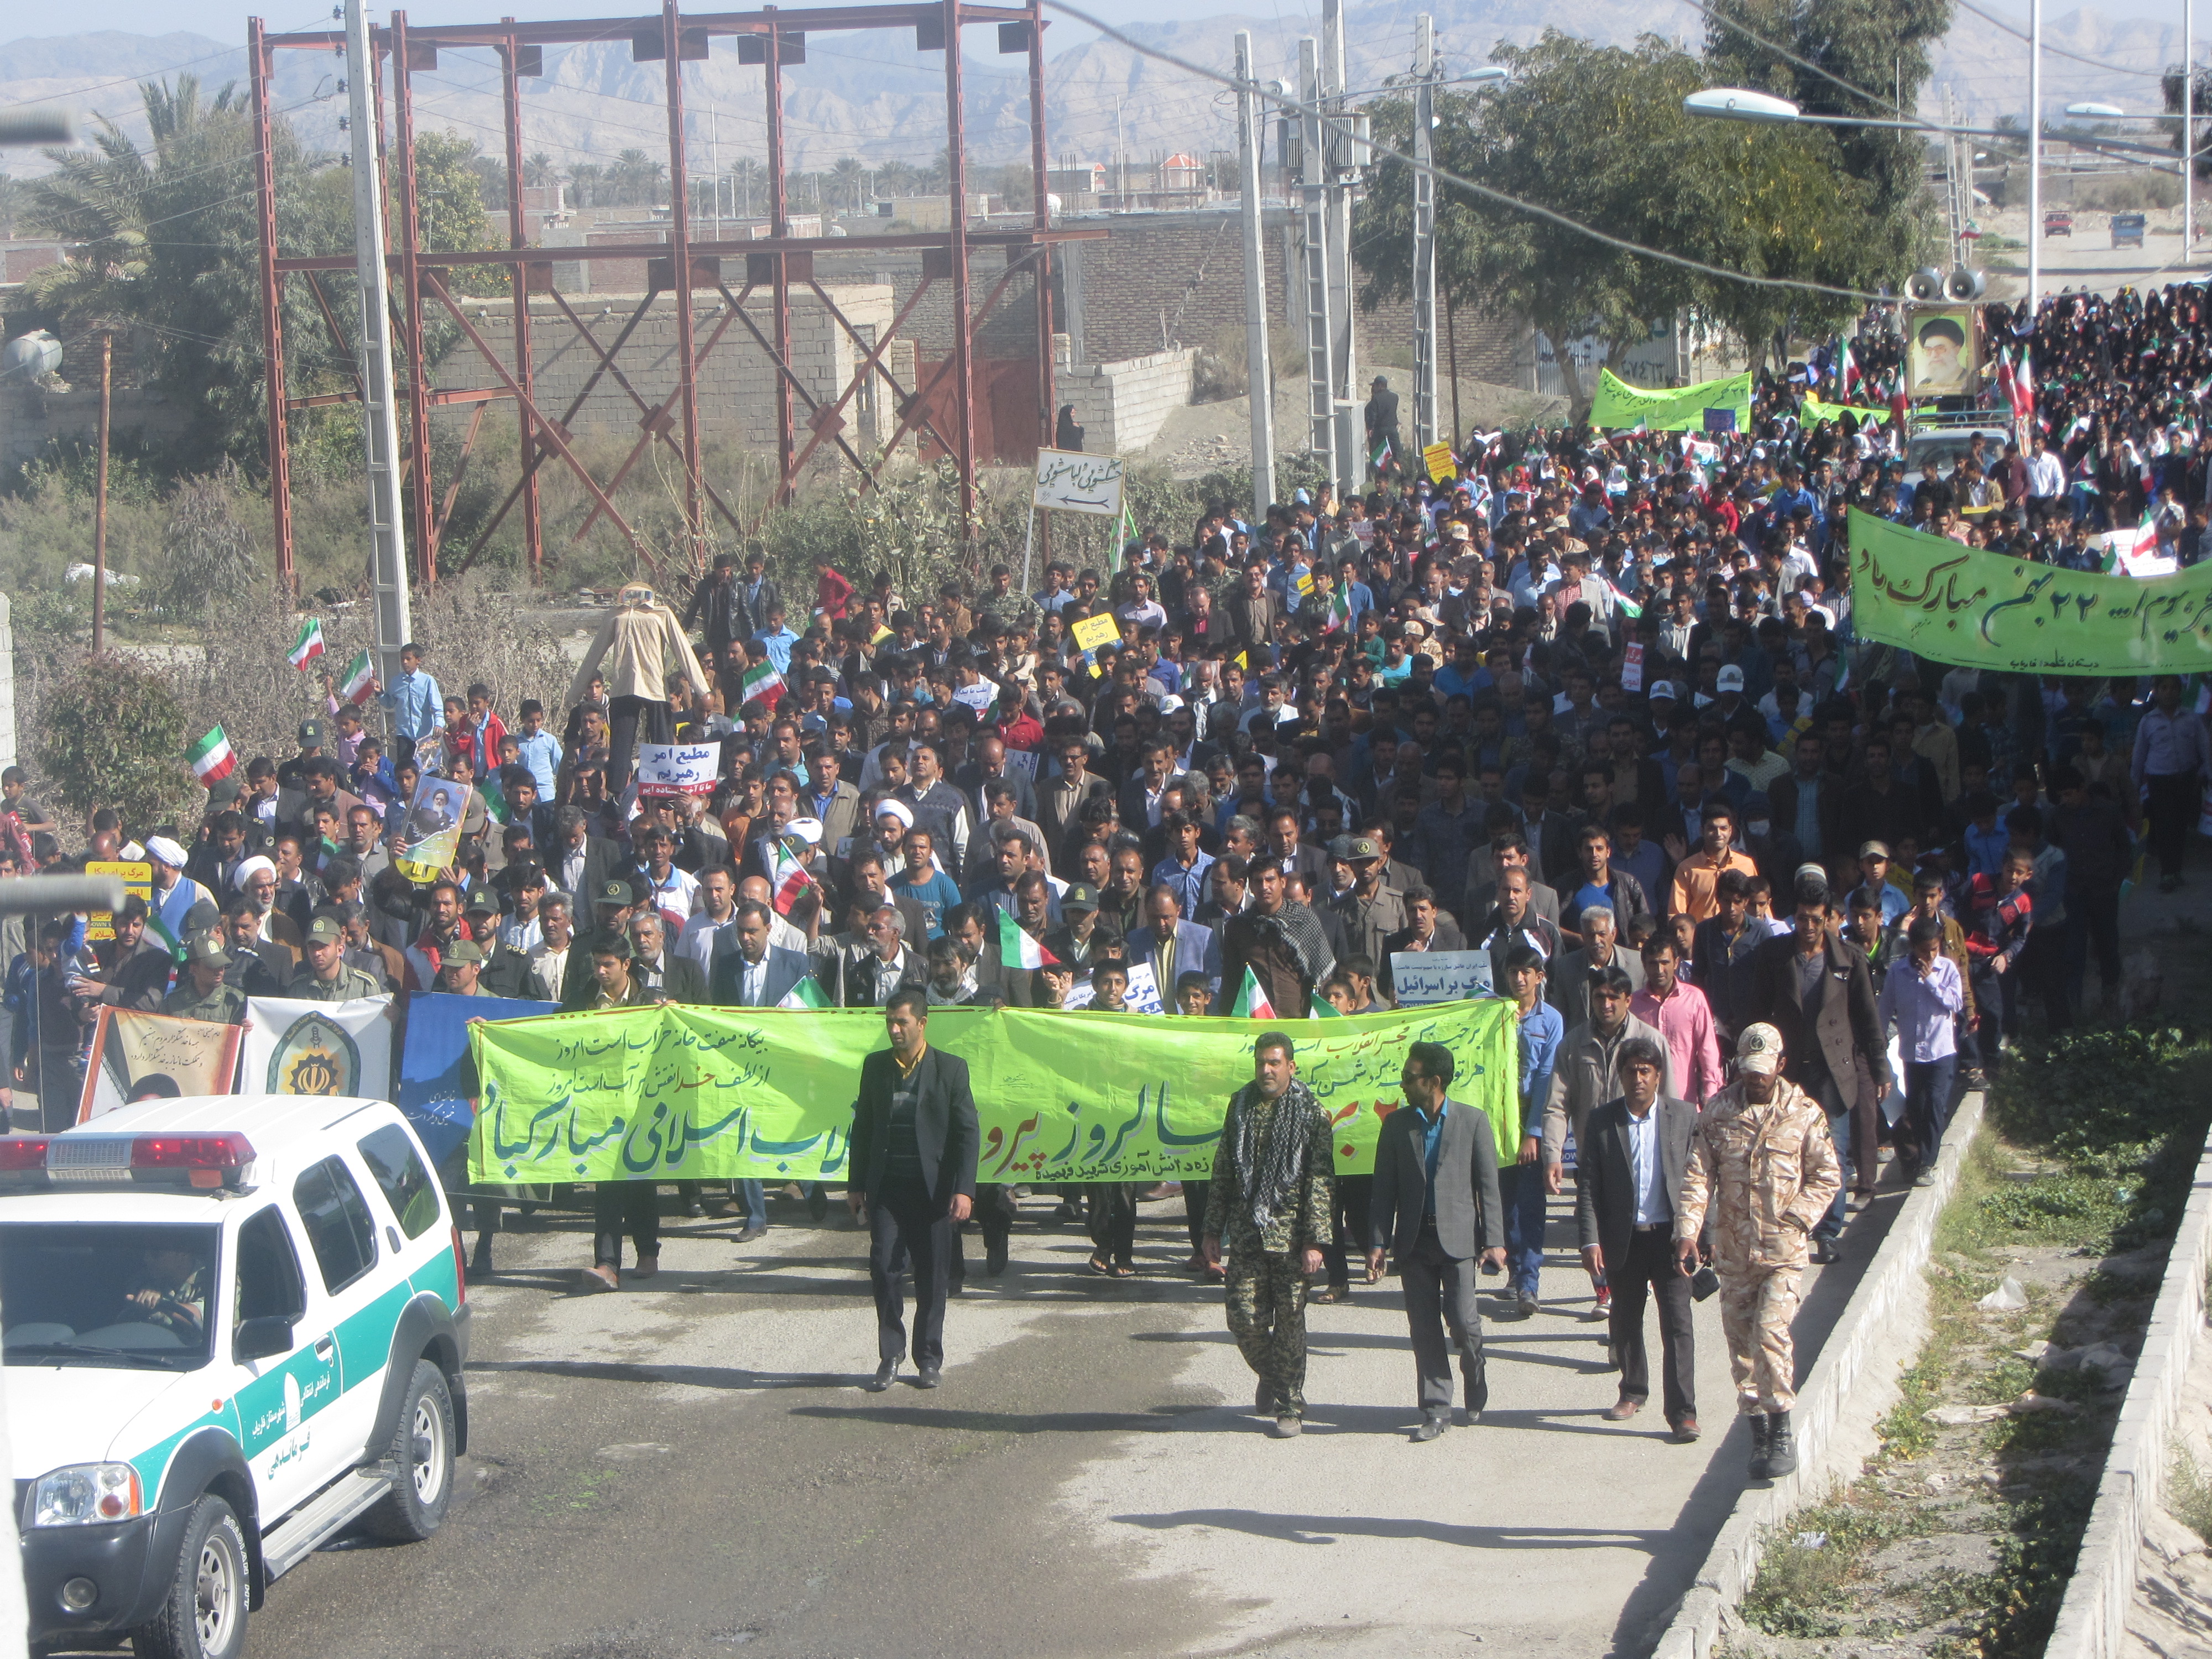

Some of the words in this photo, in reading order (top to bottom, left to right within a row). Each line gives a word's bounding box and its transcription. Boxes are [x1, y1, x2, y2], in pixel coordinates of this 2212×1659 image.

[1887, 554, 1987, 631] مبارک
[1981, 565, 2054, 647] بهمن
[2050, 591, 2098, 622] ۲۲
[1079, 622, 1088, 634] امر
[1090, 618, 1108, 631] مطیع
[1086, 632, 1108, 646] رهبریم
[651, 747, 674, 763] امر
[676, 747, 709, 765] مطیع
[658, 769, 700, 782] رهبریم
[643, 785, 654, 794] ایم
[128, 868, 144, 878] مرگ
[1125, 983, 1155, 1001] مرگ
[1397, 975, 1444, 995] اسرائیل
[1446, 980, 1458, 995] بر
[556, 1037, 584, 1061] امروز
[586, 1028, 627, 1056] است
[628, 1022, 672, 1054] خراب
[671, 1027, 697, 1049] خانه
[739, 1027, 768, 1055] بیگانه
[1327, 1031, 1382, 1059] انقلاب
[1374, 1020, 1410, 1056] فجر
[545, 1067, 577, 1096] امروز
[573, 1072, 604, 1093] است
[603, 1062, 640, 1098] آب
[645, 1063, 676, 1098] نقش
[673, 1065, 716, 1094] خدا
[714, 1061, 758, 1088] لطف
[751, 1065, 771, 1088] از
[633, 1077, 646, 1100] بر
[426, 1103, 444, 1124] دیگر
[437, 1105, 455, 1126] خمینی
[622, 1102, 750, 1173] اسلامی
[1035, 1161, 1075, 1181] فهمیده
[1076, 1161, 1108, 1180] شهید
[1107, 1149, 1150, 1179] آموزی
[1152, 1154, 1193, 1176] دانش
[268, 1425, 311, 1480] فرماندهی
[223, 1514, 249, 1575] ROADIAN
